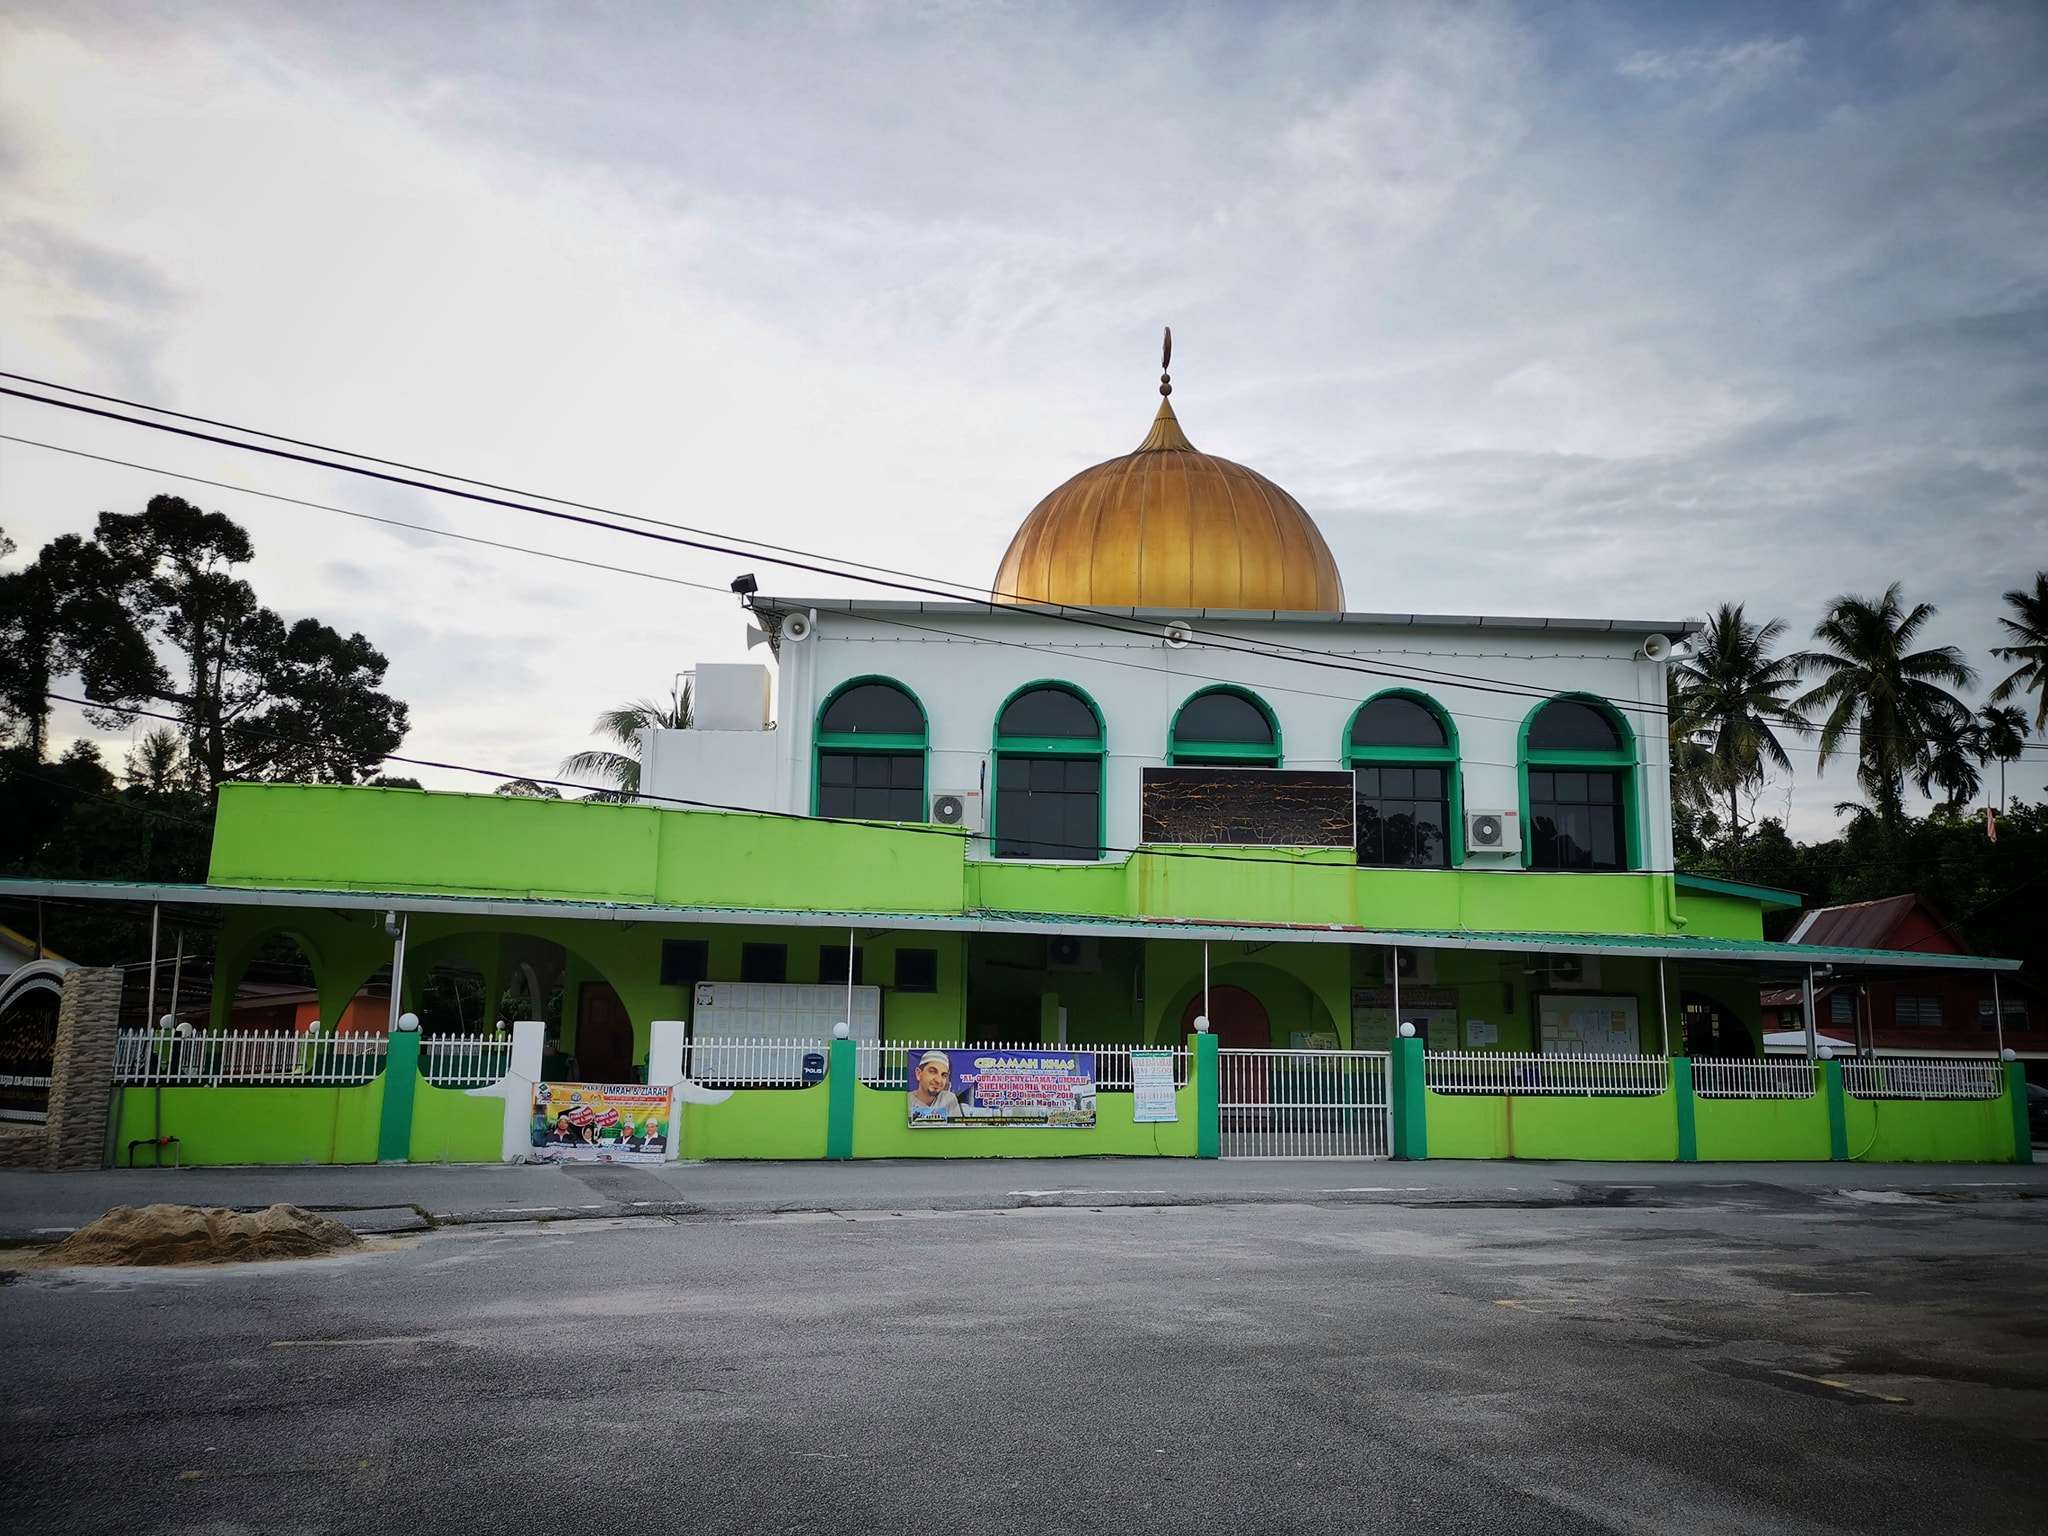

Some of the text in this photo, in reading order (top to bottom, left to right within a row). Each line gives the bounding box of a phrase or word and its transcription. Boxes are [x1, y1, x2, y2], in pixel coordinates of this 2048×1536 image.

[974, 1057, 1075, 1070] CERAMAH KHAS
[1004, 1075, 1056, 1084] PENYELAMAT
[604, 1086, 631, 1095] UMRAH
[641, 1087, 668, 1096] ZIARAH
[978, 1083, 1010, 1091] SHEIKH
[983, 1099, 1013, 1107] Selepas
[1036, 1099, 1067, 1107] Maghrib
